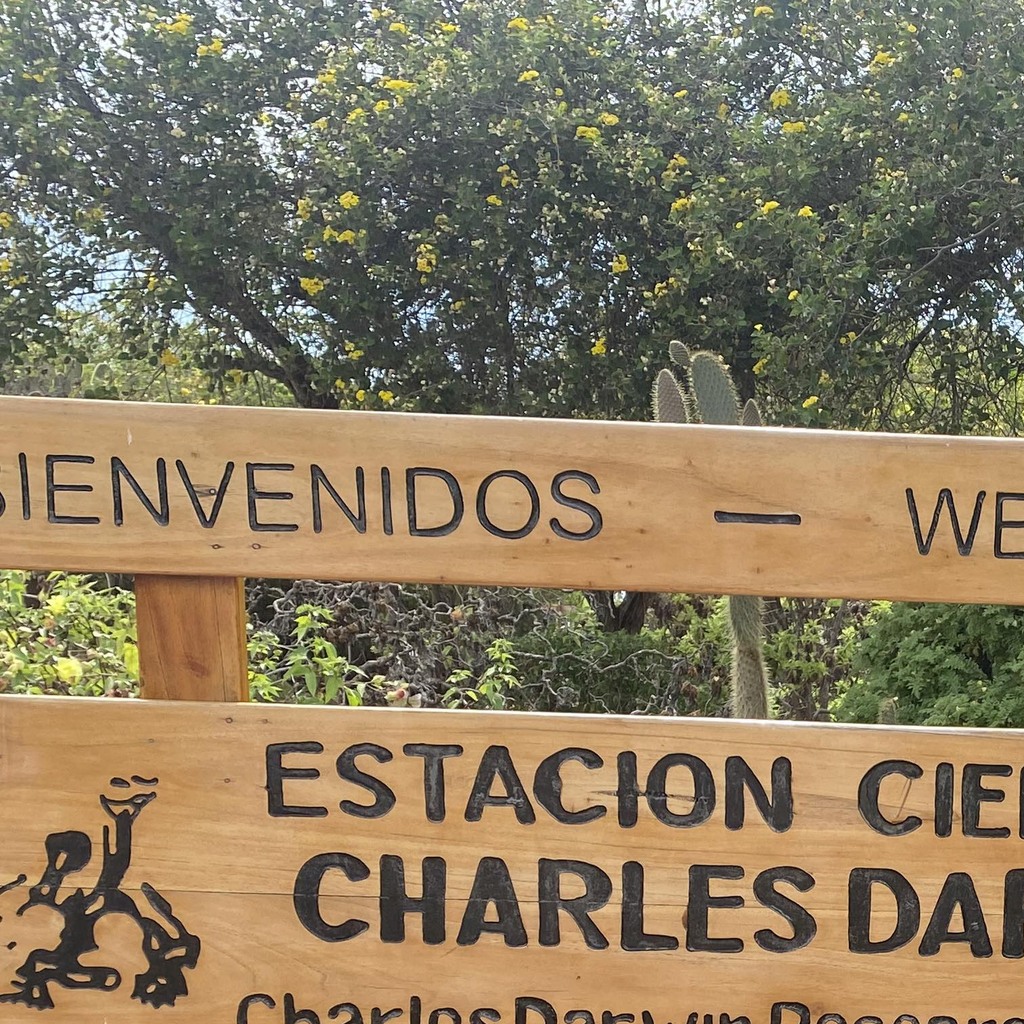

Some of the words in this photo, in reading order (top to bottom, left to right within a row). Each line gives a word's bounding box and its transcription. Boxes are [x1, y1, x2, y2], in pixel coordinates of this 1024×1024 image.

[0, 451, 604, 541] IENVENIDOS
[265, 741, 795, 834] ESTACION
[293, 852, 817, 953] CHARLES
